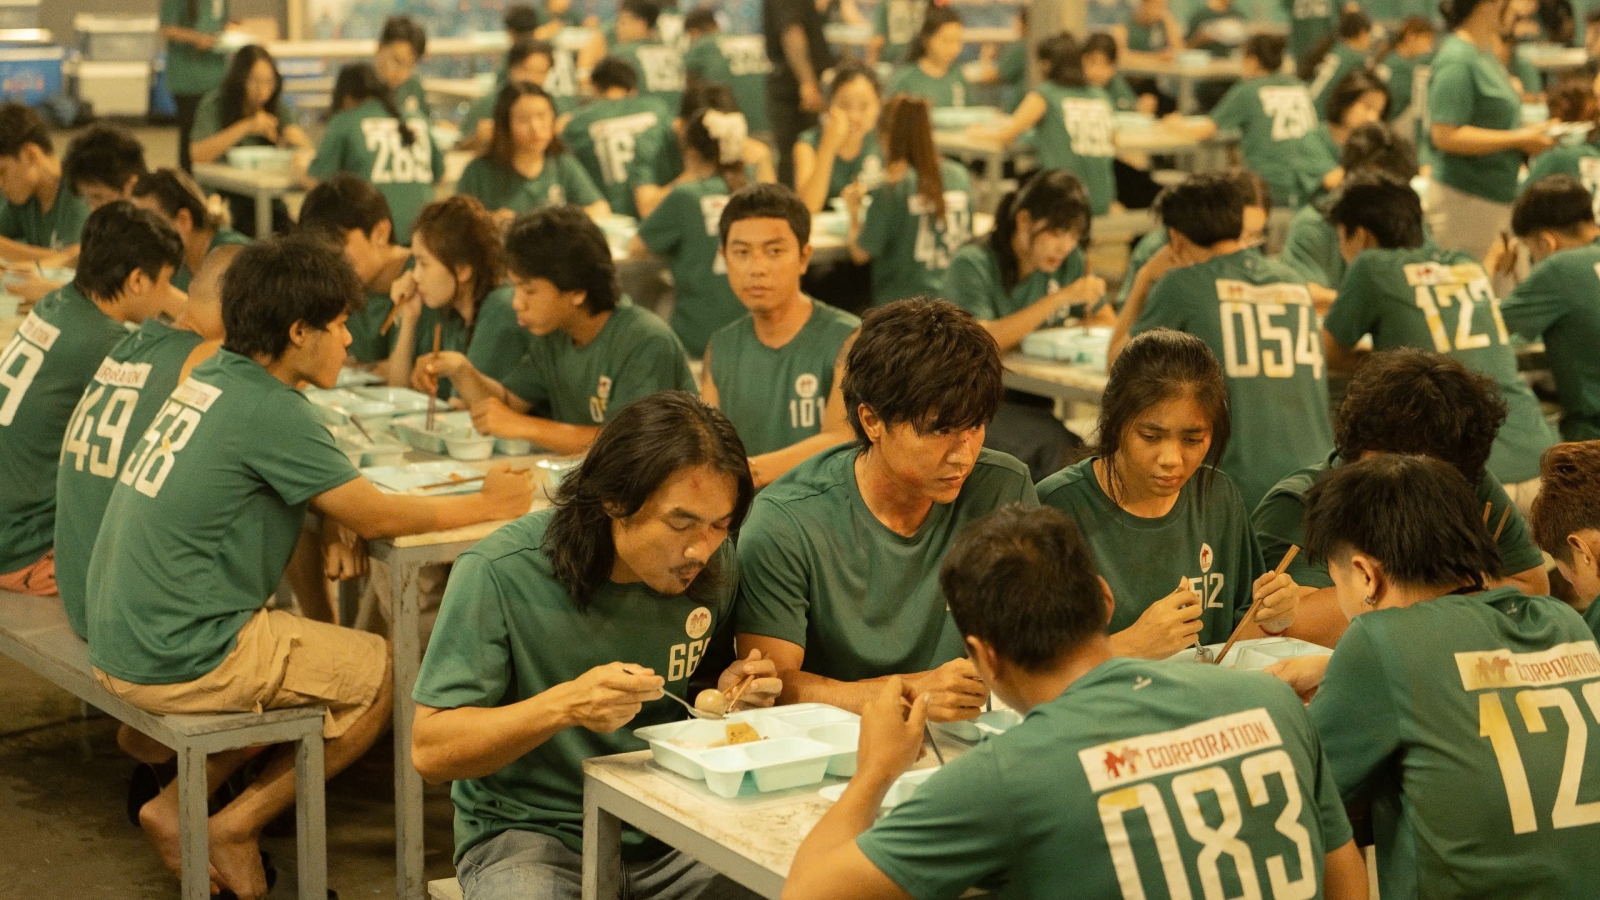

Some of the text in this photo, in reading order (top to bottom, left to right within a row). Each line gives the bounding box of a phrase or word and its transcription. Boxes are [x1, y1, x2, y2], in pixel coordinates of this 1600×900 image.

[0, 333, 44, 427] 9
[1220, 301, 1324, 380] 054
[59, 384, 140, 479] 49
[120, 399, 202, 498] 58
[789, 397, 826, 429] 101
[1188, 572, 1225, 609] 512
[667, 637, 712, 682] 66
[1145, 721, 1270, 770] CORPORATION
[1479, 681, 1600, 835] 12
[1097, 749, 1317, 900] 083
